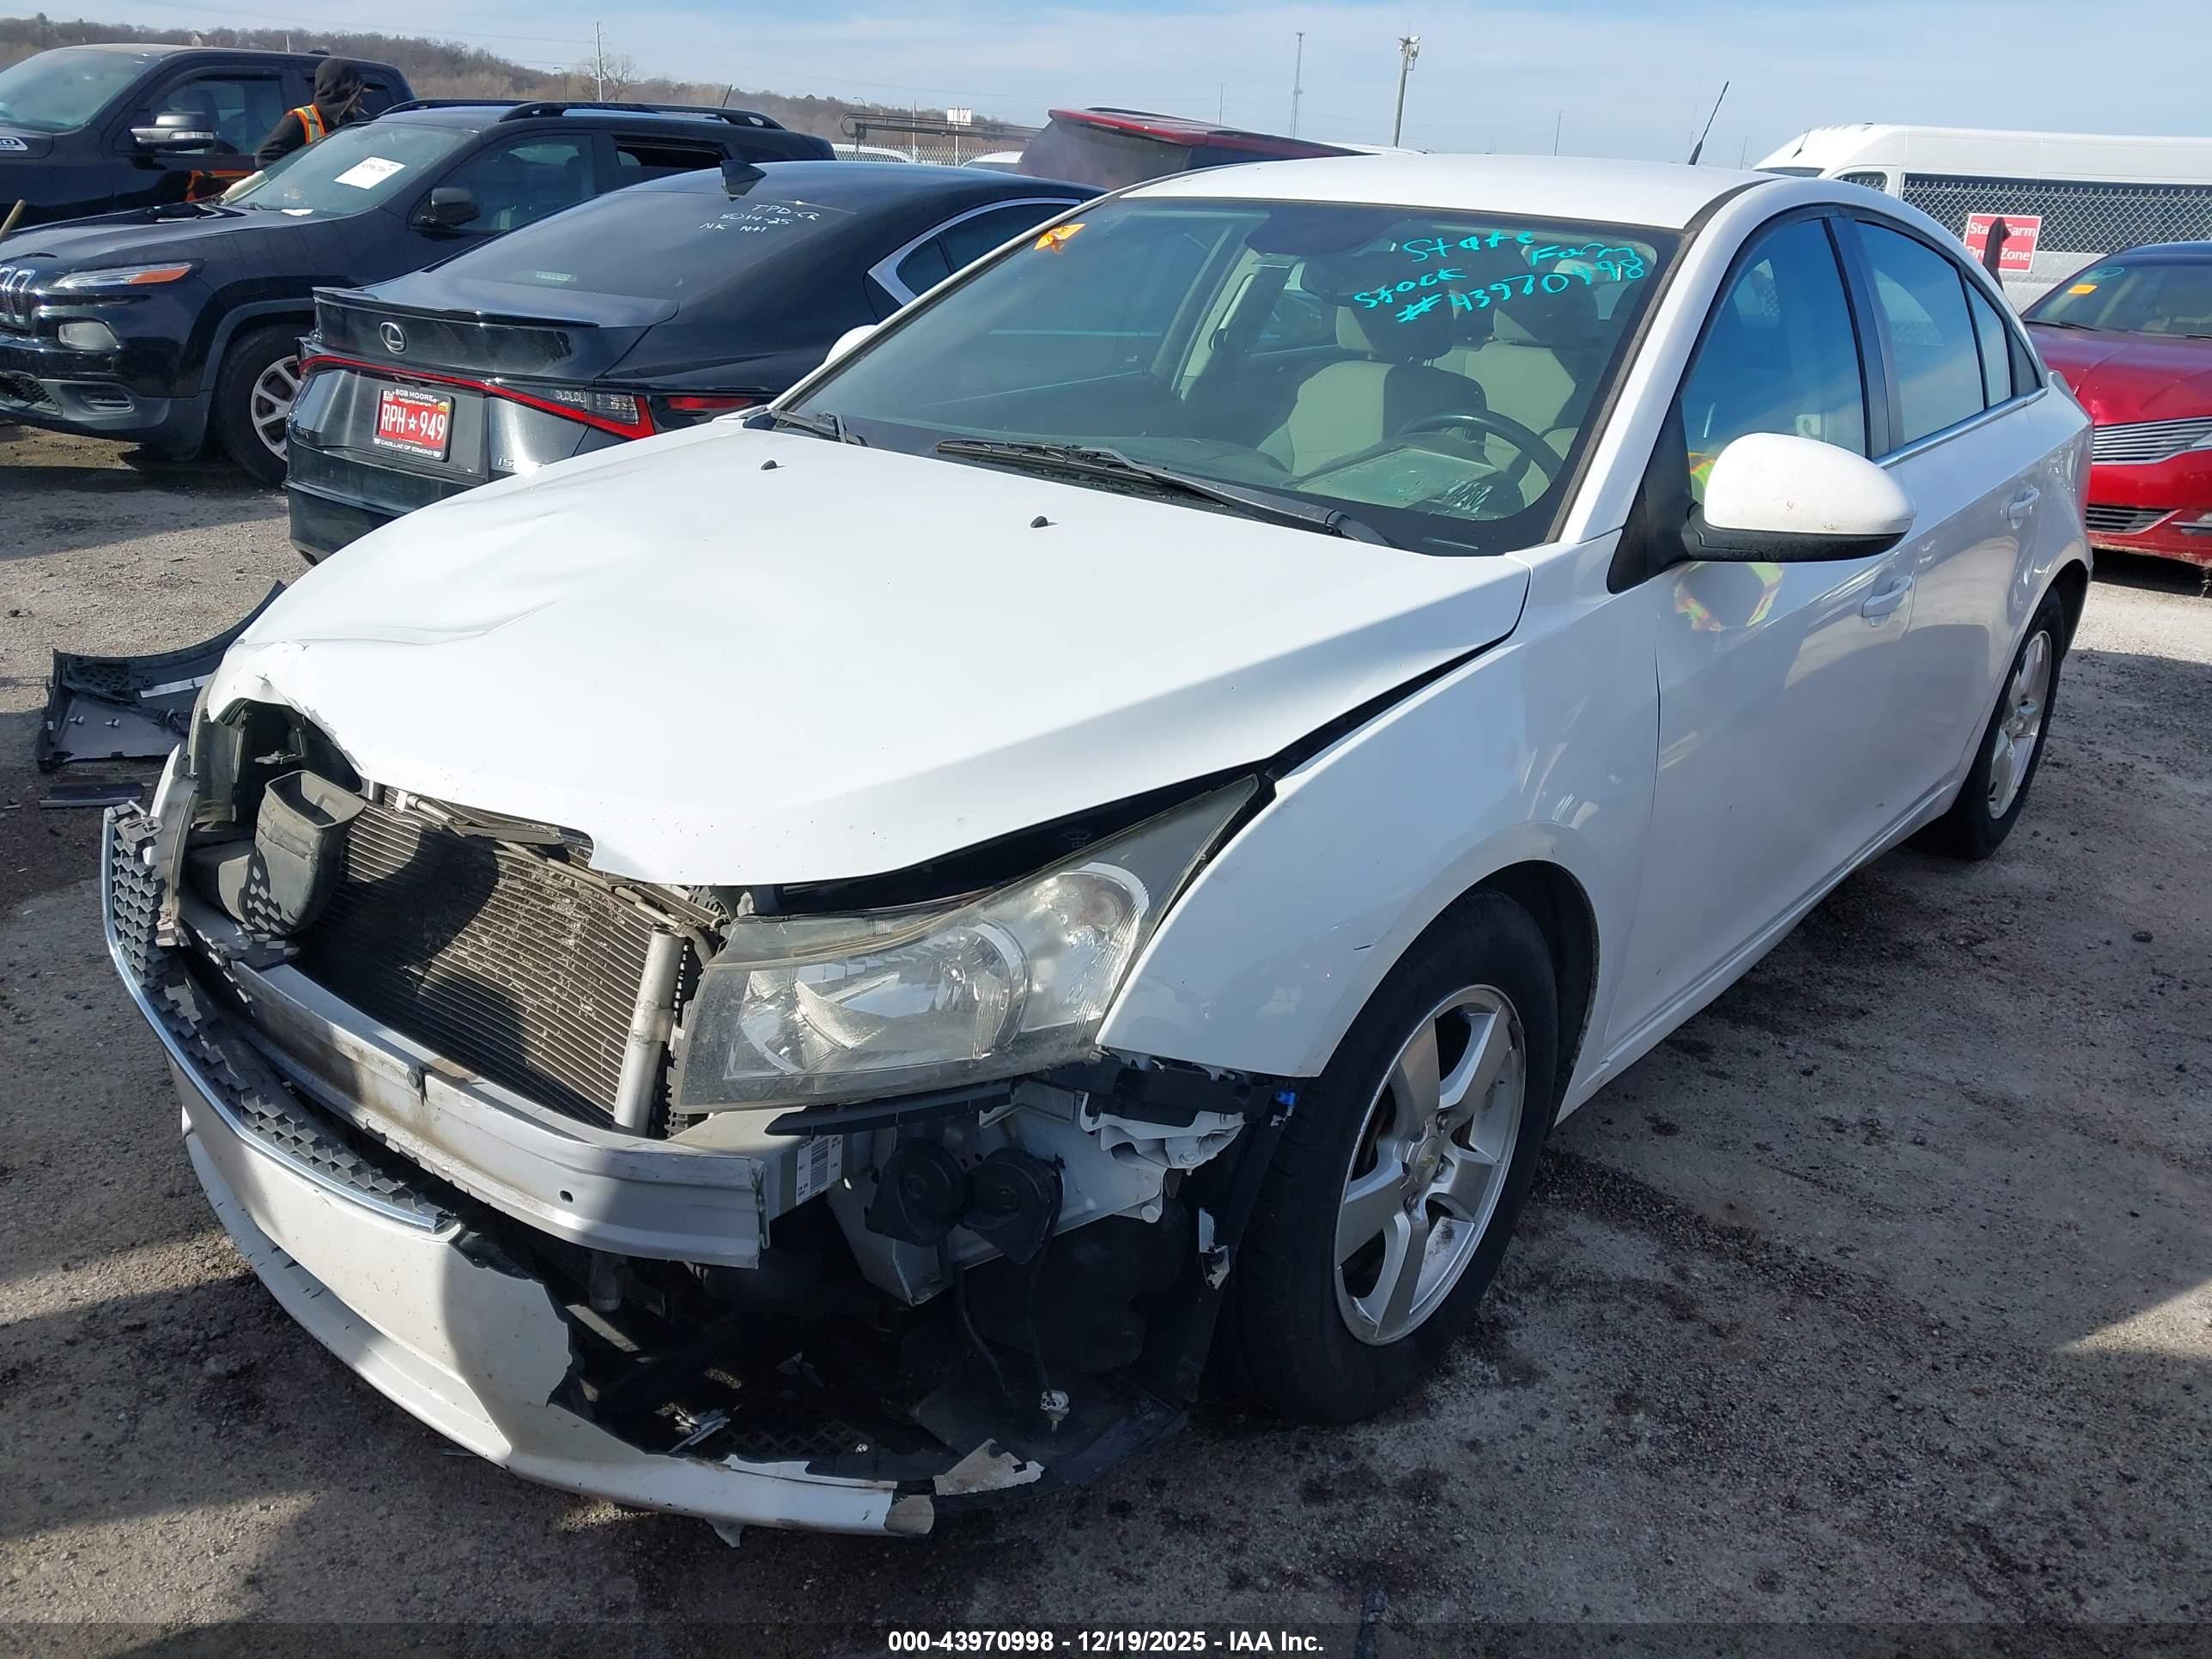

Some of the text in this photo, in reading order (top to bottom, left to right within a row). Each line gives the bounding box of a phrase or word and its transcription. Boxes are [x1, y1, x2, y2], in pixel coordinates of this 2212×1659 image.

[1969, 222, 1990, 235] Sta
[1401, 229, 1637, 267] State Farm
[1967, 246, 2031, 261] Dr Zone
[1353, 268, 1468, 309] Stock
[395, 388, 409, 397] BOB
[409, 391, 434, 402] MOORE
[380, 403, 446, 441] RPH 949
